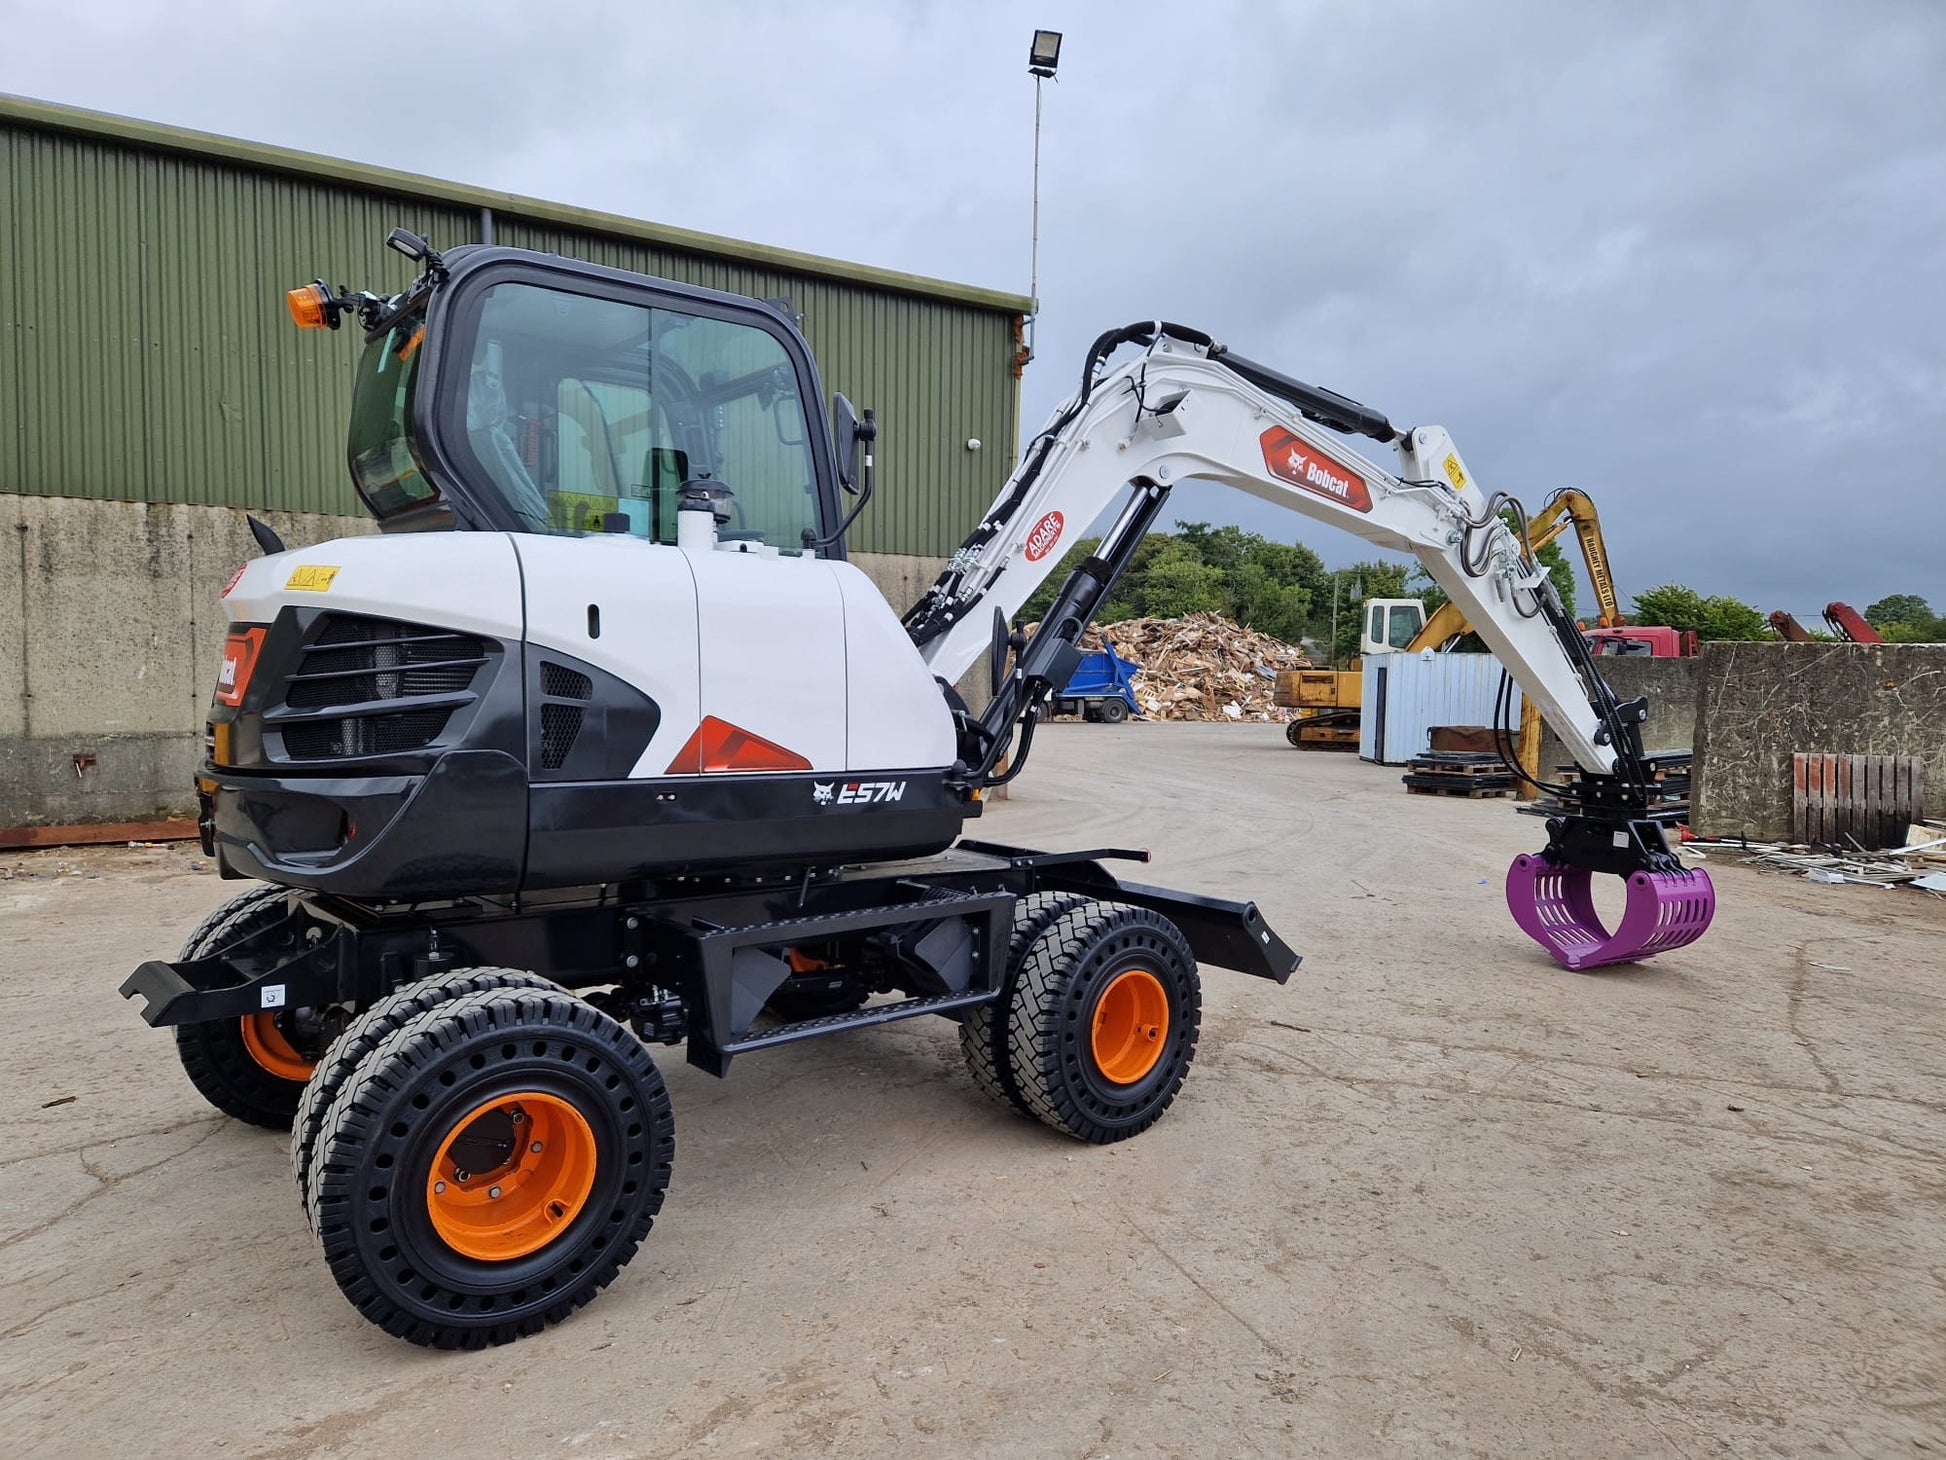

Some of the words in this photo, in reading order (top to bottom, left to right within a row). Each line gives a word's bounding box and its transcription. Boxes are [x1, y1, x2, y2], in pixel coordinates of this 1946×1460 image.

[1306, 461, 1349, 498] Bobcat
[1029, 512, 1058, 556] ADARE
[1596, 569, 1610, 595] METALS
[1603, 593, 1613, 607] LTD
[836, 780, 907, 804] E57W
